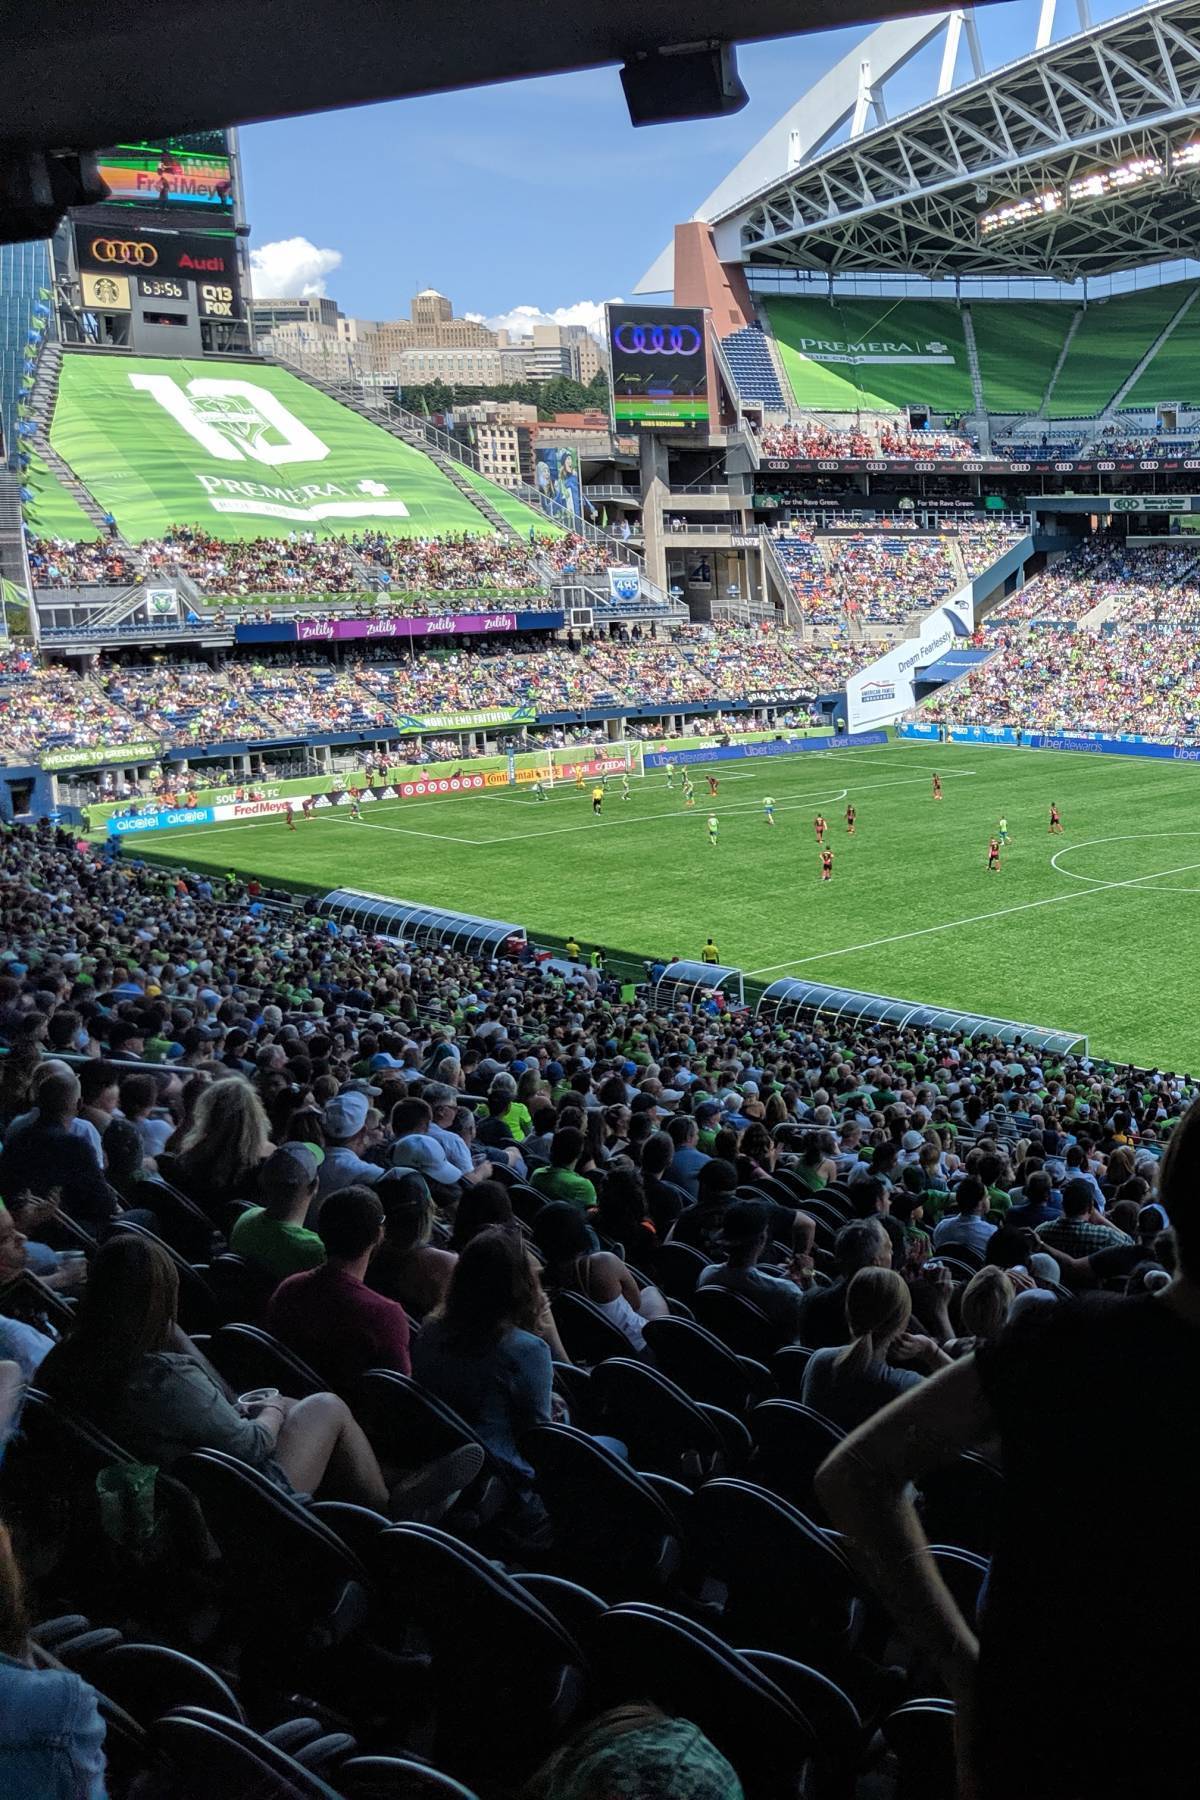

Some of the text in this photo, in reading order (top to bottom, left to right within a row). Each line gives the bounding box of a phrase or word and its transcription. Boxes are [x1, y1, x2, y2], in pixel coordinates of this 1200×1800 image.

[178, 252, 225, 272] Audi
[202, 285, 233, 302] Q13
[205, 301, 233, 316] FOX
[800, 338, 913, 353] PREMERA
[195, 475, 352, 504] PREMERA
[898, 631, 951, 673] Dream Fearlessly
[826, 738, 848, 748] Uber
[1039, 738, 1104, 752] Uber Rewards
[44, 747, 156, 764] WELCOME TO GREEN HELL
[744, 746, 767, 757] Uber
[1174, 747, 1200, 760] Uber
[652, 751, 719, 768] Uber Rewards
[116, 816, 159, 831] alcatel
[168, 809, 208, 824] alcatel
